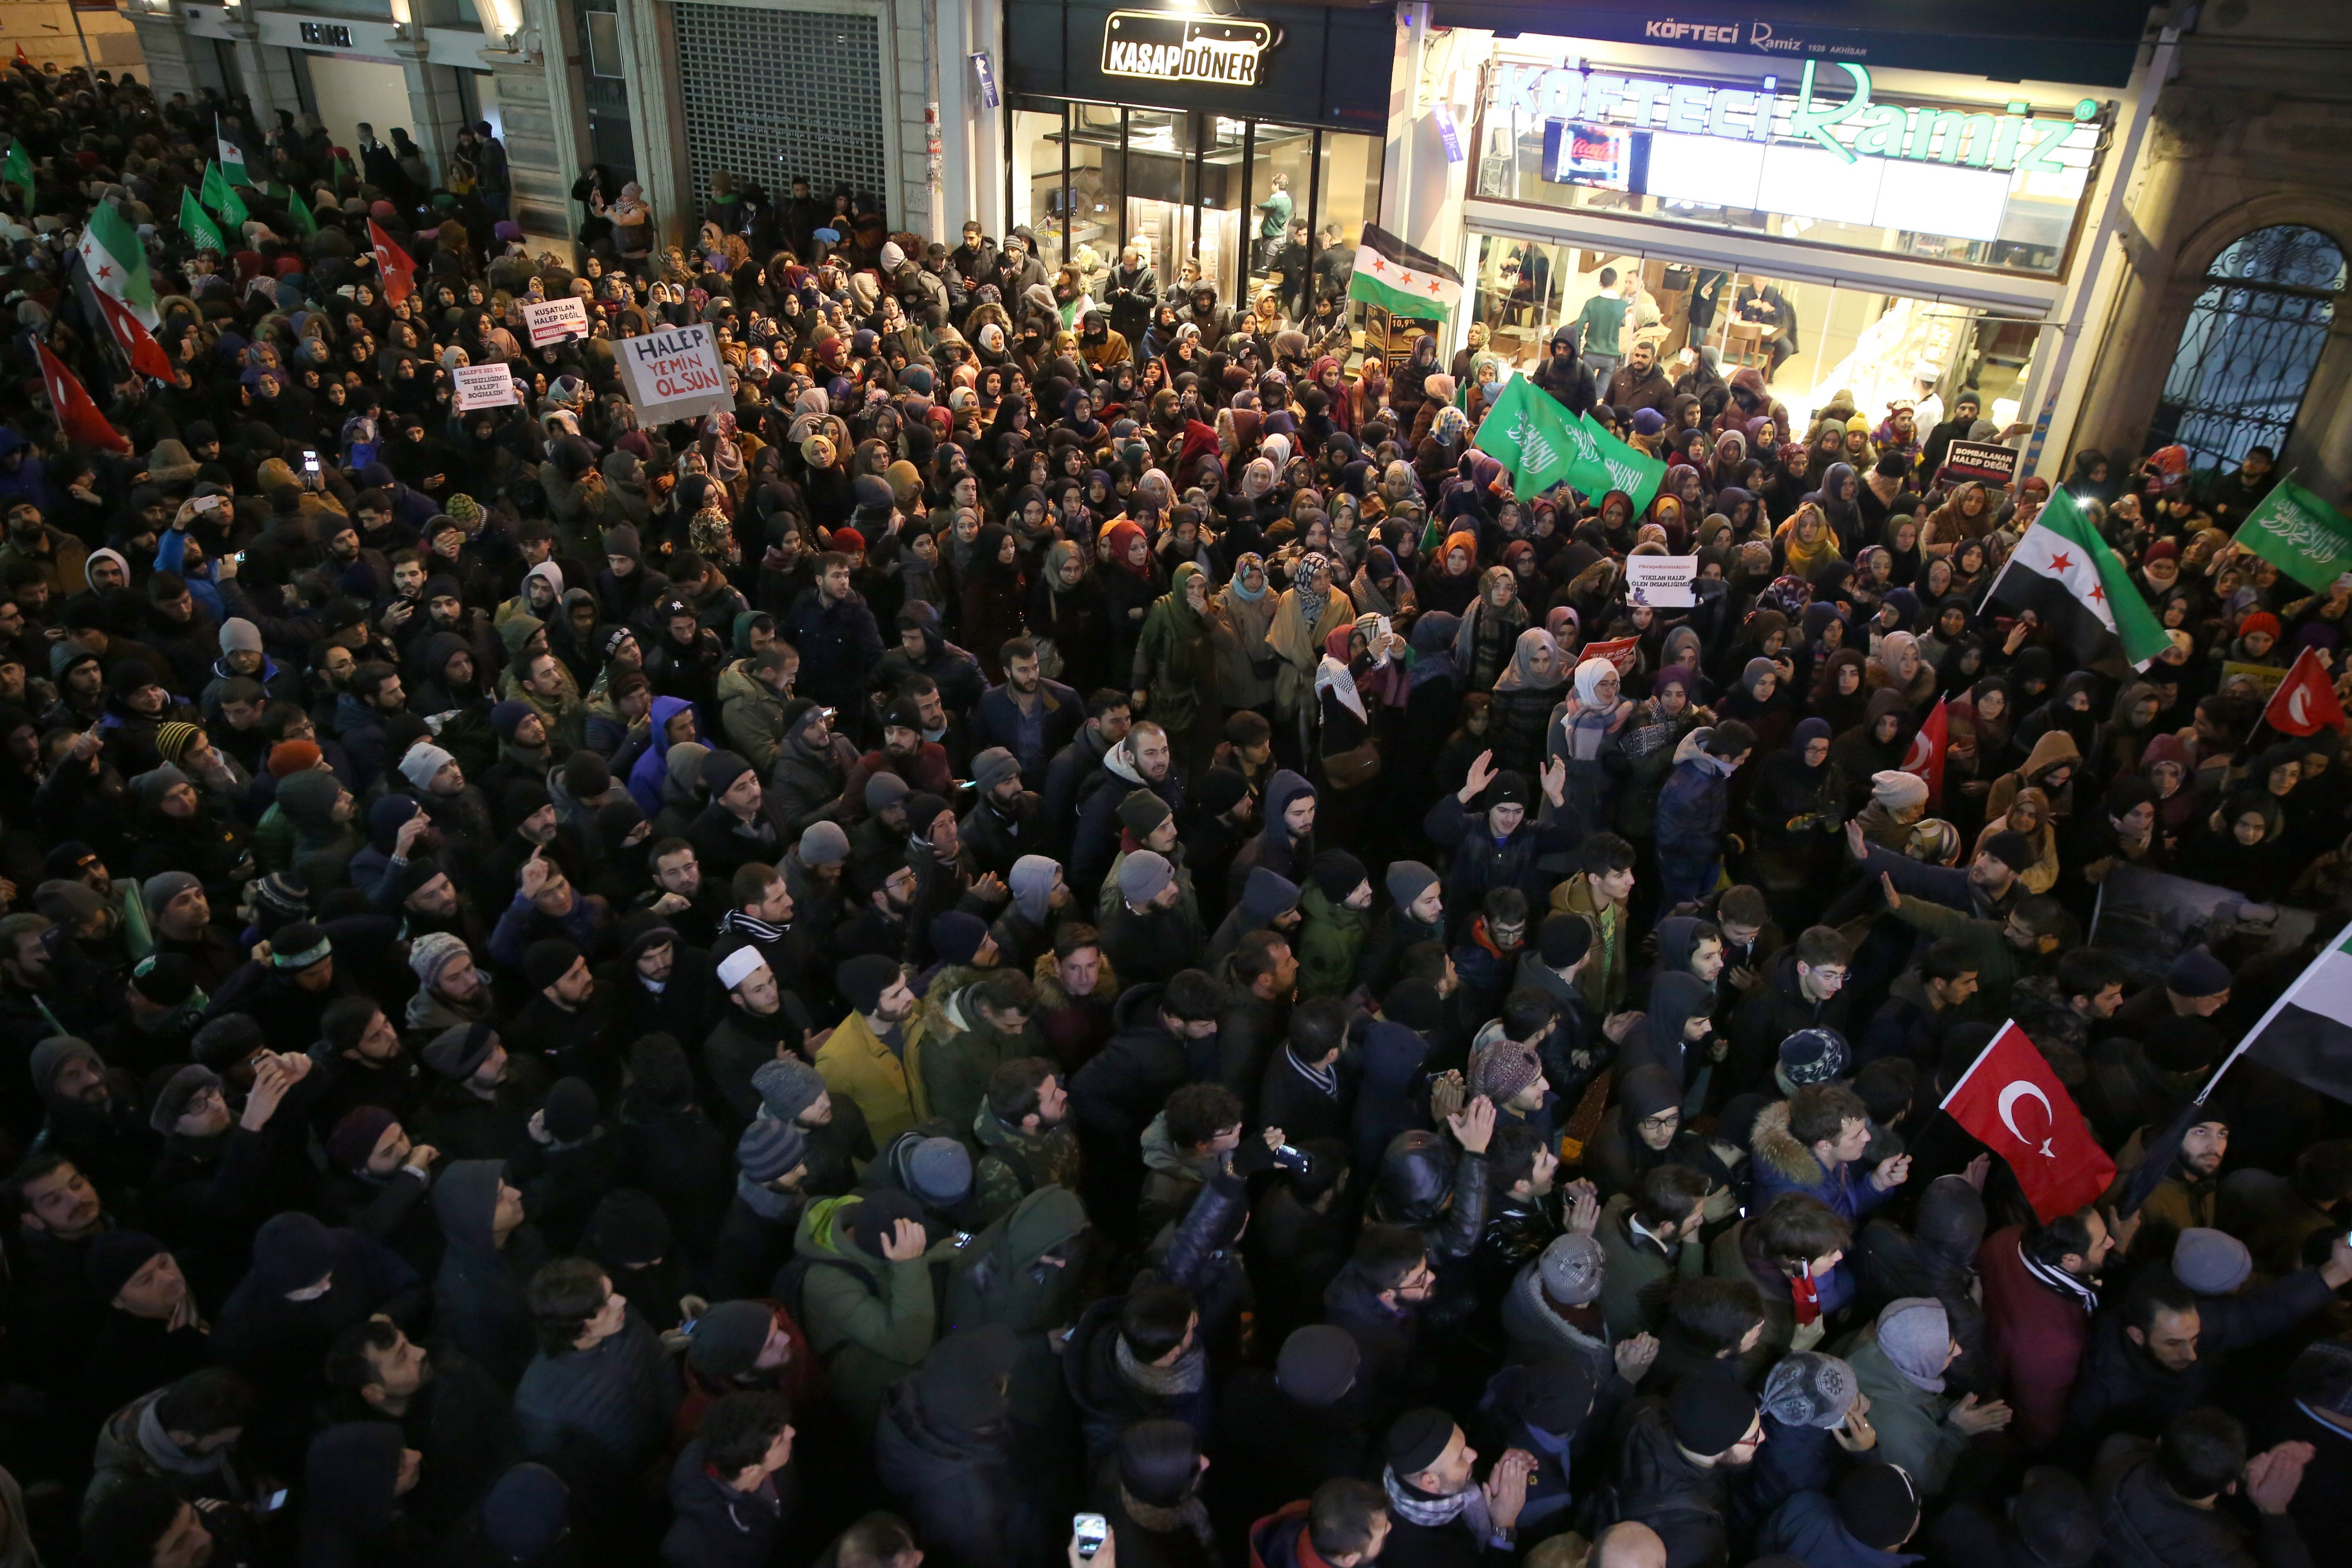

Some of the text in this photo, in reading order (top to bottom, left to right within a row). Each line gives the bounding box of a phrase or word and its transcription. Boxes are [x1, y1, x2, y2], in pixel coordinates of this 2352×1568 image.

[1645, 18, 1739, 44] KÖFTECİ
[1750, 18, 1804, 52] Ramiz
[1498, 56, 1777, 142] KÖFTECİ
[534, 311, 582, 325] HALEP DEĞİL,
[535, 304, 575, 316] KUŞATILAN
[635, 329, 704, 361] HALEP
[646, 352, 703, 377] YEMİN
[656, 368, 720, 397] OLSUN
[1951, 454, 1982, 466] HALEP
[1983, 459, 2013, 474] DEĞİL,
[1955, 448, 2013, 463] BOMBALANAN
